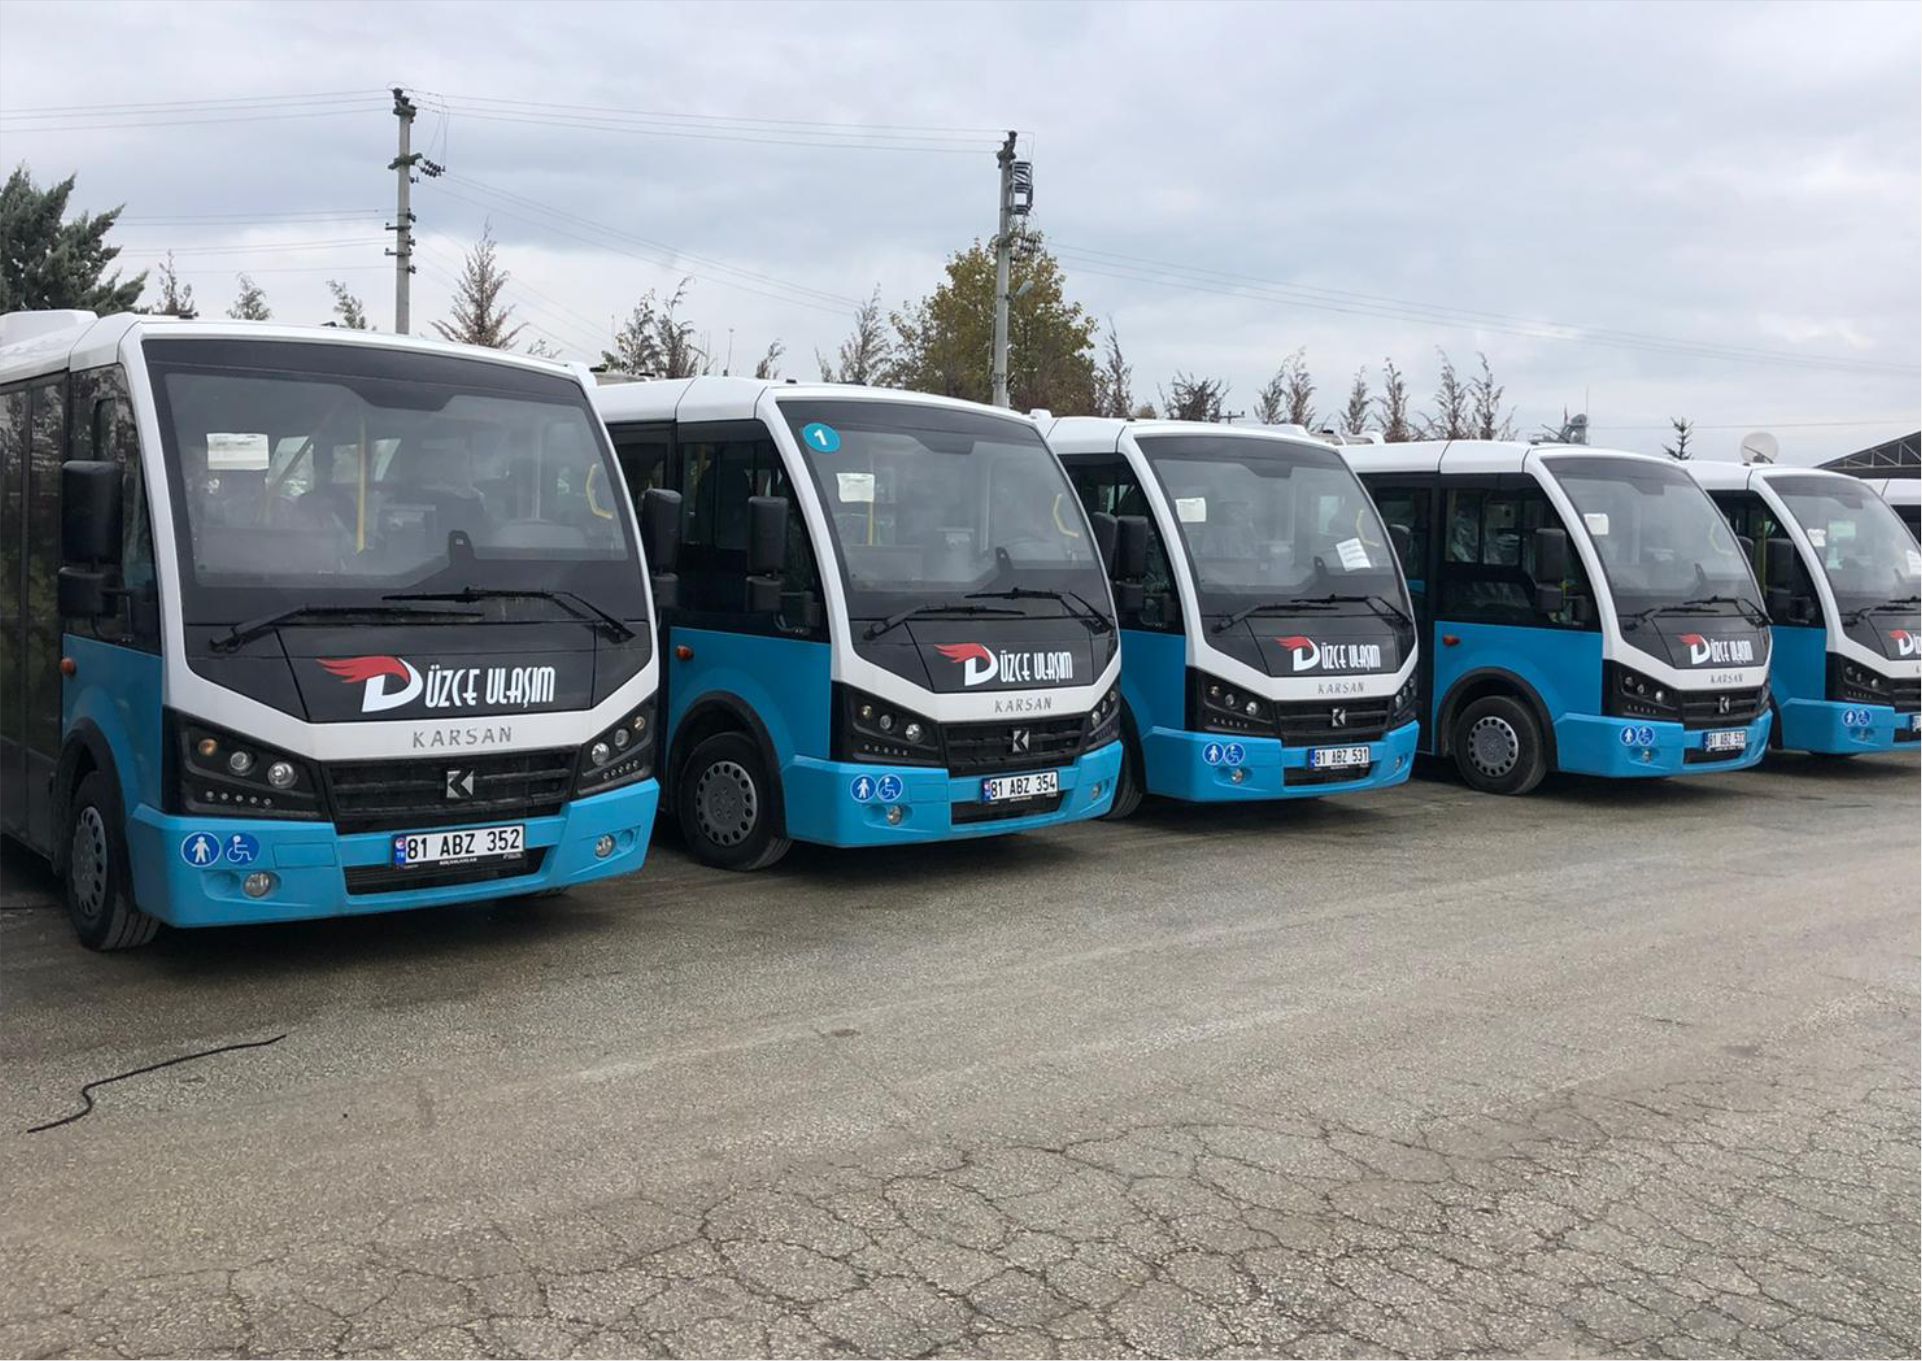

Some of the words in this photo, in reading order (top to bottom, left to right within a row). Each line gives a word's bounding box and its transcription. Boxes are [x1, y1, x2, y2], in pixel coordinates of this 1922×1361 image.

[814, 429, 828, 446] 1
[934, 643, 1031, 687] DÜZCE
[1033, 651, 1074, 683] ULAŞIM
[1274, 635, 1347, 672] DÜZCE
[316, 655, 480, 713] DÜZCE
[485, 666, 556, 708] ULAŞIM
[1317, 682, 1365, 695] KARSAN
[994, 696, 1053, 714] KARSAN
[412, 726, 512, 749] KARSAN
[1315, 751, 1326, 765] 81
[1331, 749, 1348, 764] ABZ
[1352, 748, 1368, 762] 531
[991, 781, 1003, 797] 81
[1009, 777, 1030, 796] ABZ
[1035, 774, 1056, 792] 354
[407, 838, 427, 860] 81
[439, 832, 476, 857] ABZ
[487, 828, 520, 852] 352
